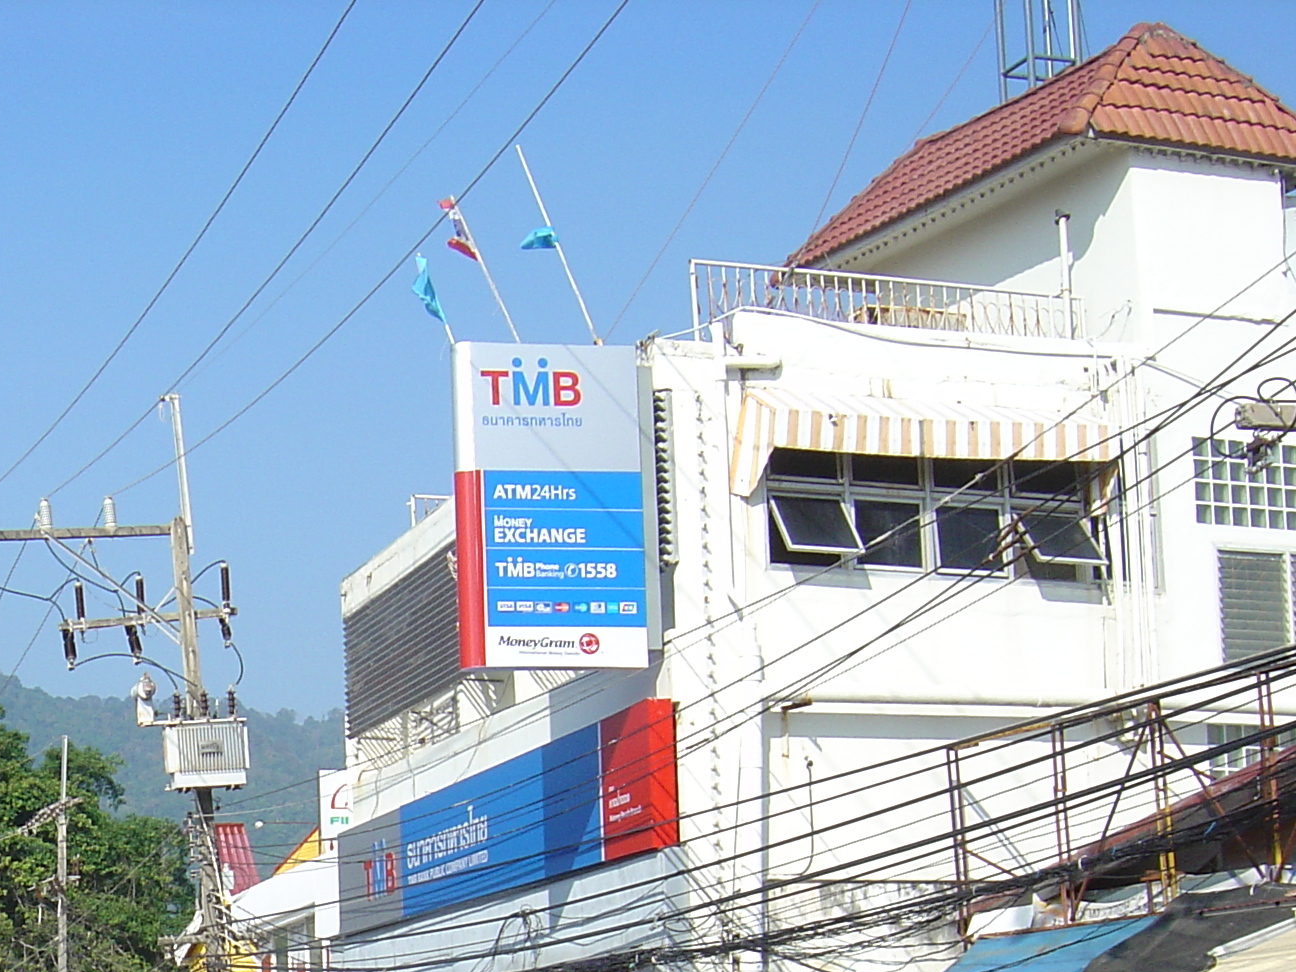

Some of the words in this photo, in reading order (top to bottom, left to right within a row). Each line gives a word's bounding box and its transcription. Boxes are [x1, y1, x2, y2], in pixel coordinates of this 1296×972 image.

[480, 357, 582, 407] TMB
[482, 412, 583, 427] ธนาคารทหารไทย
[493, 484, 577, 500] ATM24Hrs
[494, 528, 587, 543] EXCHANGE
[494, 557, 536, 578] TMB
[578, 563, 618, 578] 1558
[497, 635, 575, 650] MoneyGram
[363, 838, 397, 902] TMB
